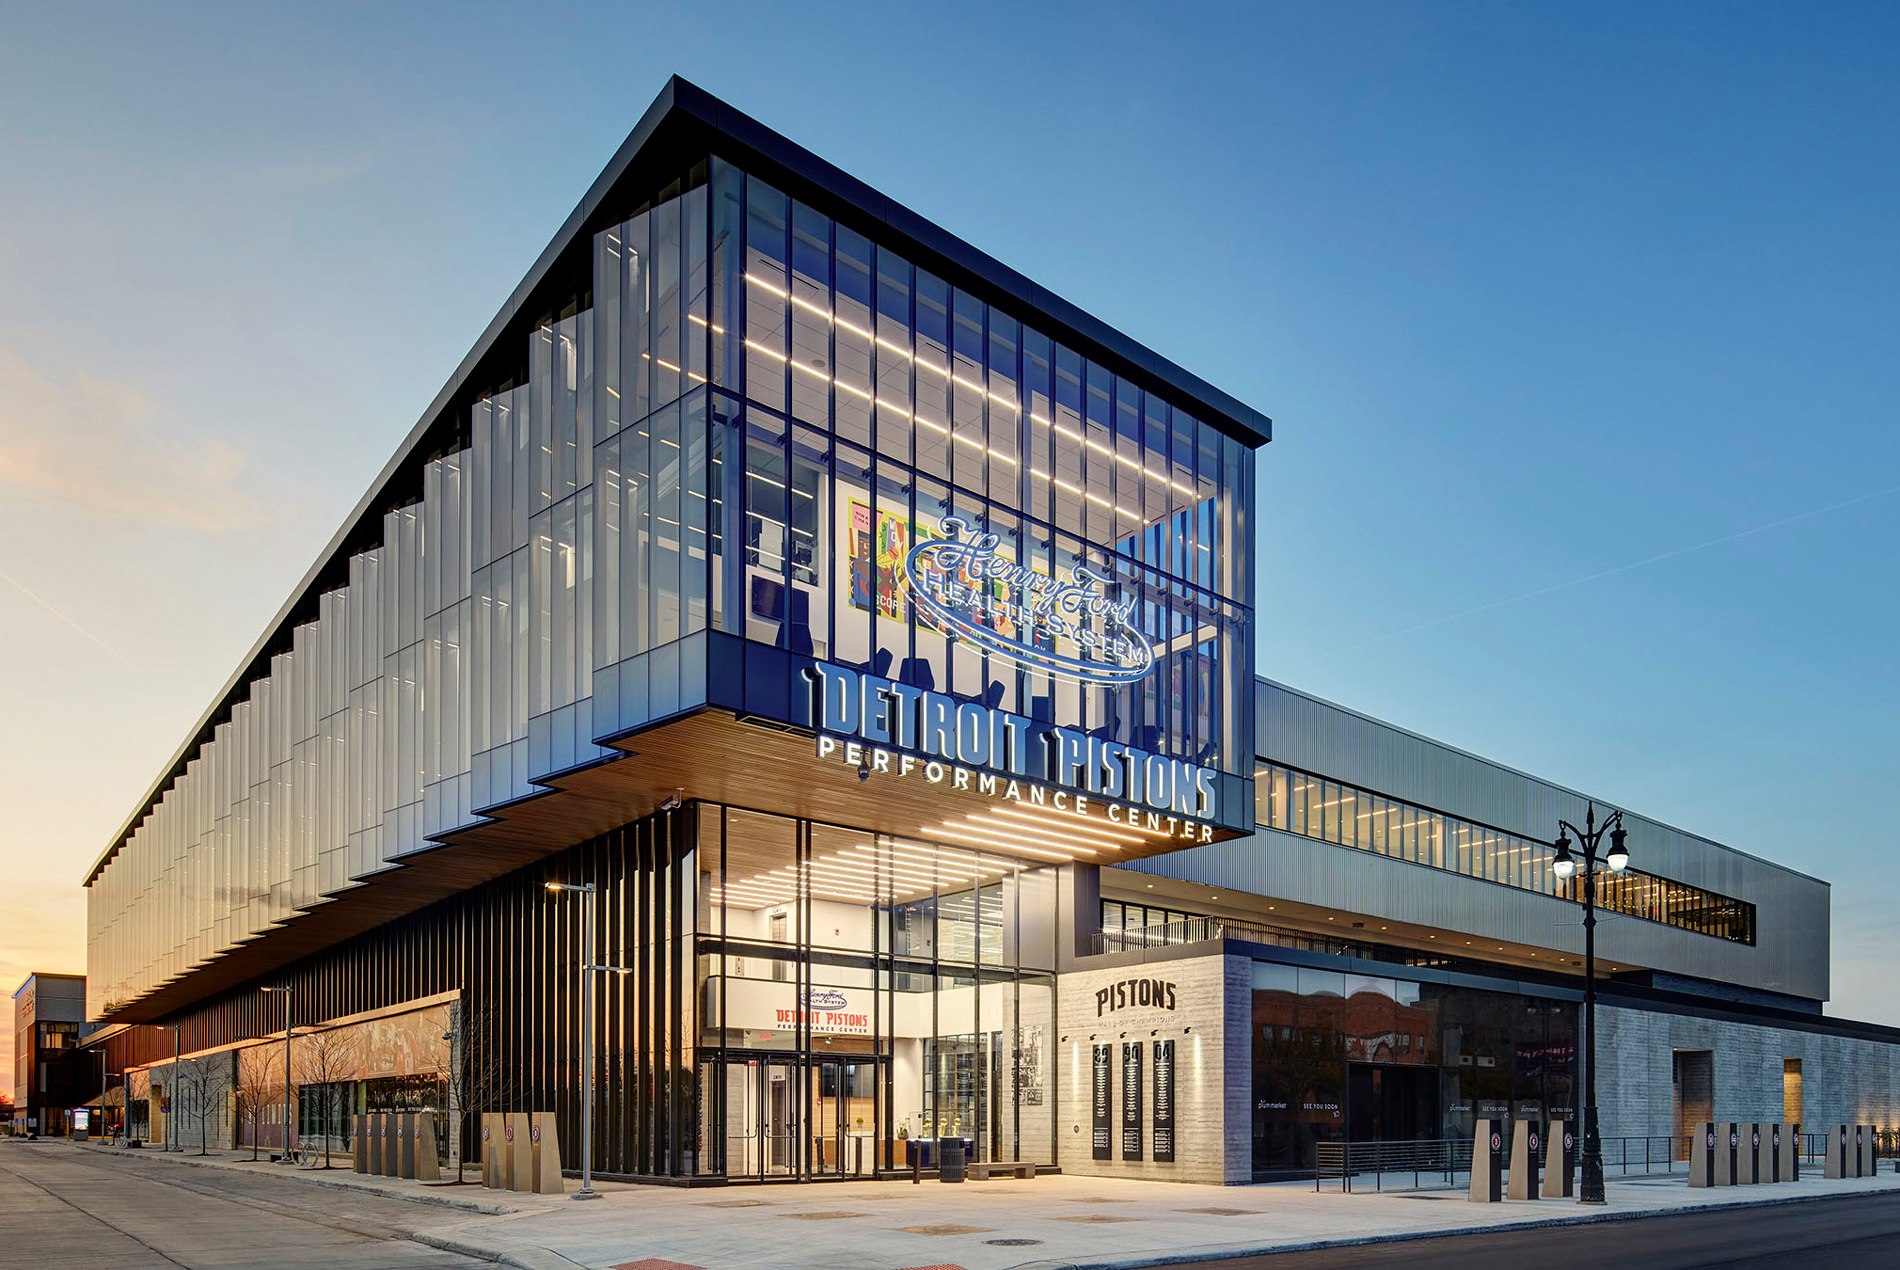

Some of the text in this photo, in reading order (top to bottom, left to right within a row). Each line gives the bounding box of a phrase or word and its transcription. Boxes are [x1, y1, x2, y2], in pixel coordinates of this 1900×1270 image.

[923, 568, 1149, 665] HEALTH SYSTEM
[936, 516, 1139, 626] Henry Ford
[813, 661, 1217, 820] DETROIT PISTONS
[817, 736, 1213, 843] PERFORMANCE CENTER
[777, 1024, 835, 1032] PERFMANCE
[826, 1012, 868, 1027] PISTONS
[1095, 979, 1176, 1017] PISTONS
